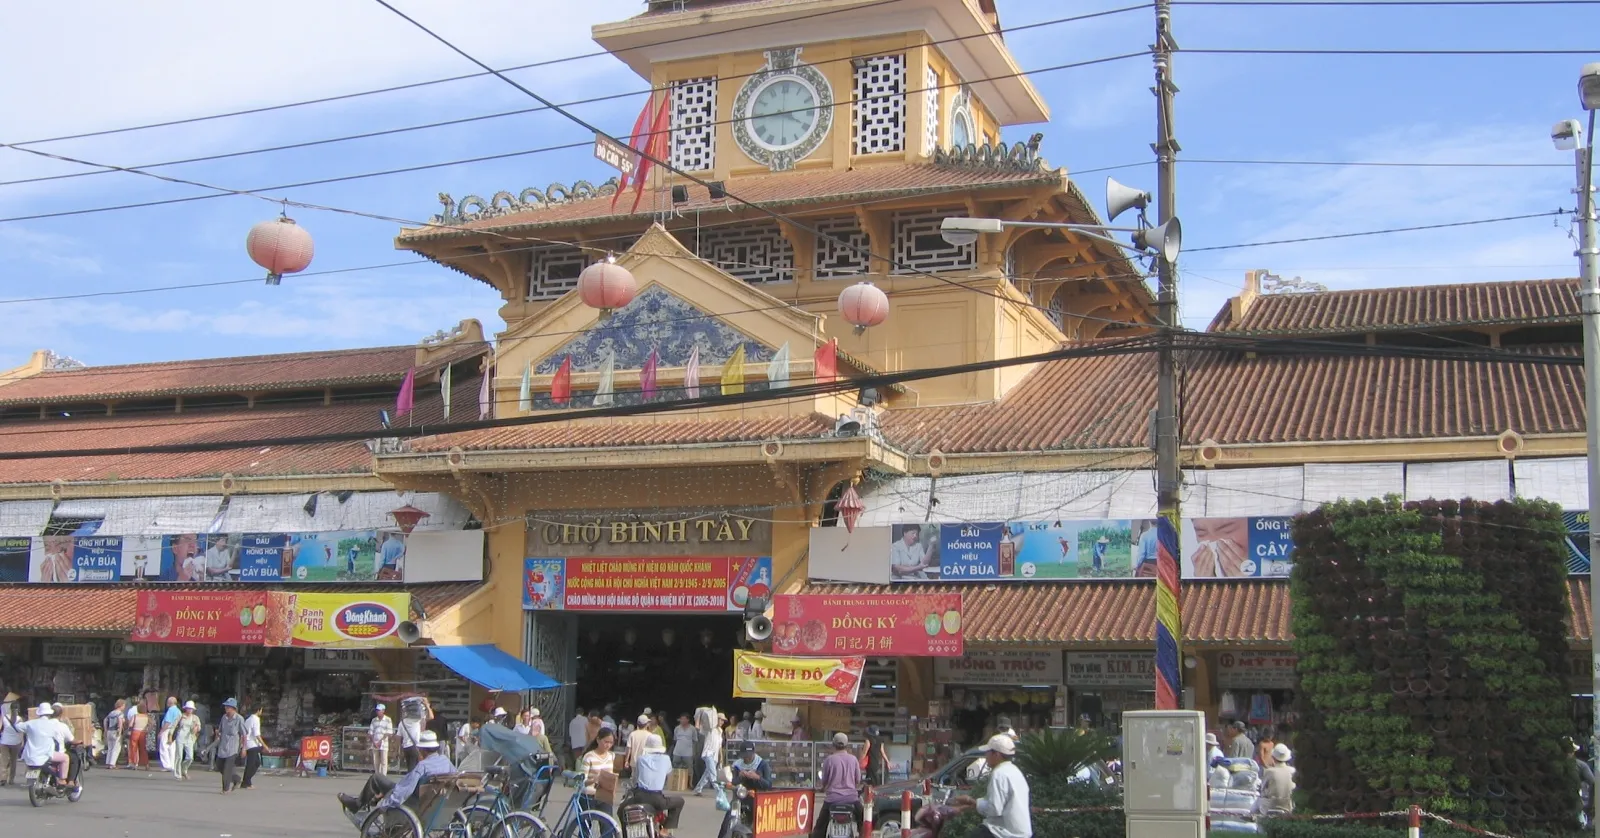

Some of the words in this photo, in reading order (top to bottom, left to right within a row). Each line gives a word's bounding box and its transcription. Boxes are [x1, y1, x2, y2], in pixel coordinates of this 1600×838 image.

[606, 150, 619, 166] CAO
[542, 519, 602, 550] CHỢ
[696, 512, 755, 541] TÂY
[1256, 517, 1281, 531] ỐNG
[947, 539, 972, 550] HỒNG
[973, 541, 993, 550] HOA
[1256, 541, 1288, 557] CÂY
[77, 556, 96, 567] CÂY
[961, 552, 978, 561] HIỆU
[242, 566, 259, 577] CÂY
[260, 566, 279, 577] BÚA
[532, 562, 562, 573] 2/9
[581, 560, 596, 574] NHIỆT
[597, 560, 608, 574] LIỆT
[660, 562, 667, 572] 60
[679, 559, 693, 574] QUỐC
[694, 560, 712, 573] KHÁNH
[943, 562, 967, 575] CÂY
[970, 561, 995, 575] BÚA
[567, 575, 580, 588] NƯỚC
[581, 575, 594, 589] CỘNG
[613, 576, 622, 590] HỘI
[622, 575, 633, 588] CHỦ
[650, 576, 661, 590] VIỆT
[661, 577, 673, 588] NAM
[673, 577, 698, 588] 2/9/1945
[701, 577, 727, 588] 2/9/2005
[597, 595, 606, 608] ĐẠI
[606, 592, 616, 608] HỘI
[631, 592, 640, 607] BỘ
[640, 593, 655, 607] QUẬN
[659, 593, 679, 608] NHIỆM
[686, 595, 693, 606] IX
[693, 595, 725, 607] (2005-2010)
[823, 597, 842, 606] BÁNH
[843, 598, 865, 606] TRUNG
[866, 598, 879, 606] THU
[880, 598, 895, 606] CAO
[896, 597, 909, 606] CẤP
[207, 608, 222, 621] KÝ
[299, 615, 324, 625] Trung
[832, 611, 873, 629] ĐỒNG
[876, 613, 899, 629] KÝ
[175, 626, 217, 638] 同記月餅
[834, 635, 893, 650] 同記月餅
[1000, 657, 1047, 670] TRÚC
[1107, 659, 1132, 673] KIM
[754, 666, 796, 680] KINH
[756, 797, 777, 834] CẤM
